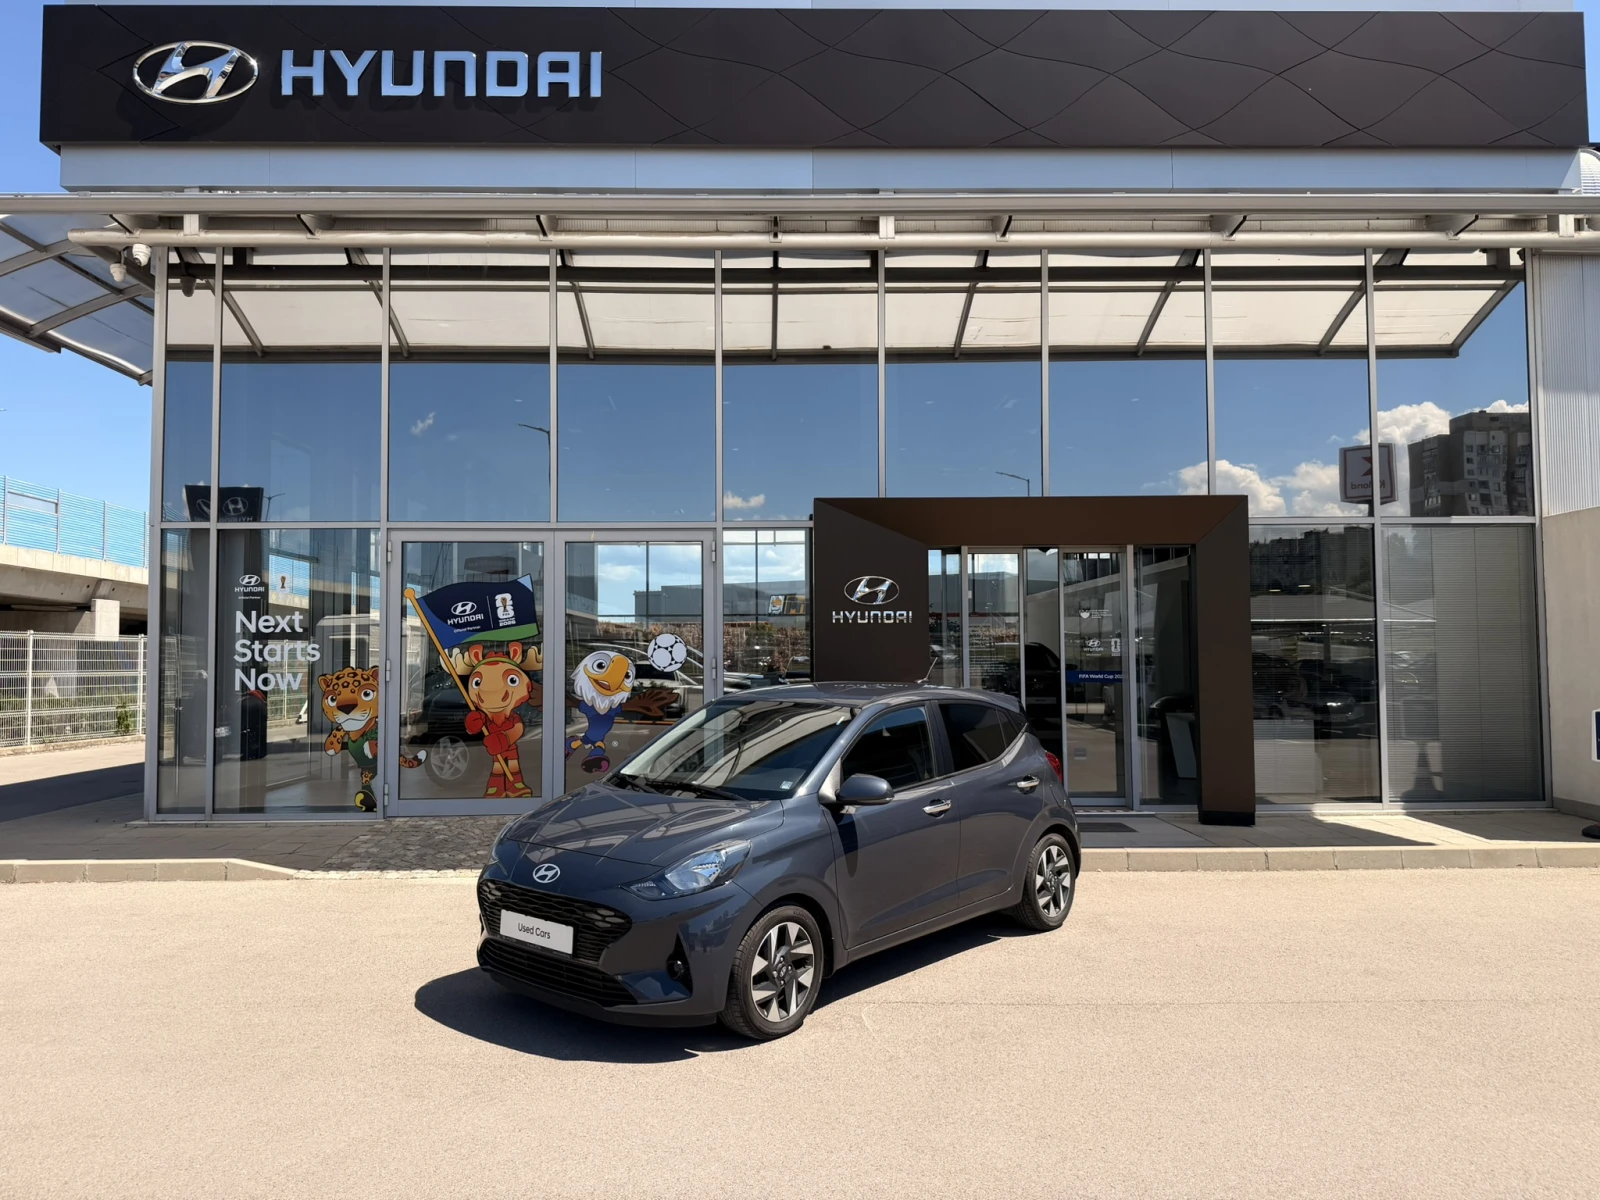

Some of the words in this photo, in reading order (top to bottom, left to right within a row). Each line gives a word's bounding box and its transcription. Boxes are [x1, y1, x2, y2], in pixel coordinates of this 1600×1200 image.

[281, 50, 602, 97] HYUNDAI
[236, 611, 303, 633] Next
[447, 613, 484, 625] HYUNDAI
[832, 611, 912, 623] HYUNDAI
[234, 639, 320, 662] Starts
[235, 668, 303, 691] Now
[518, 922, 534, 935] Used
[535, 927, 551, 939] Cars
